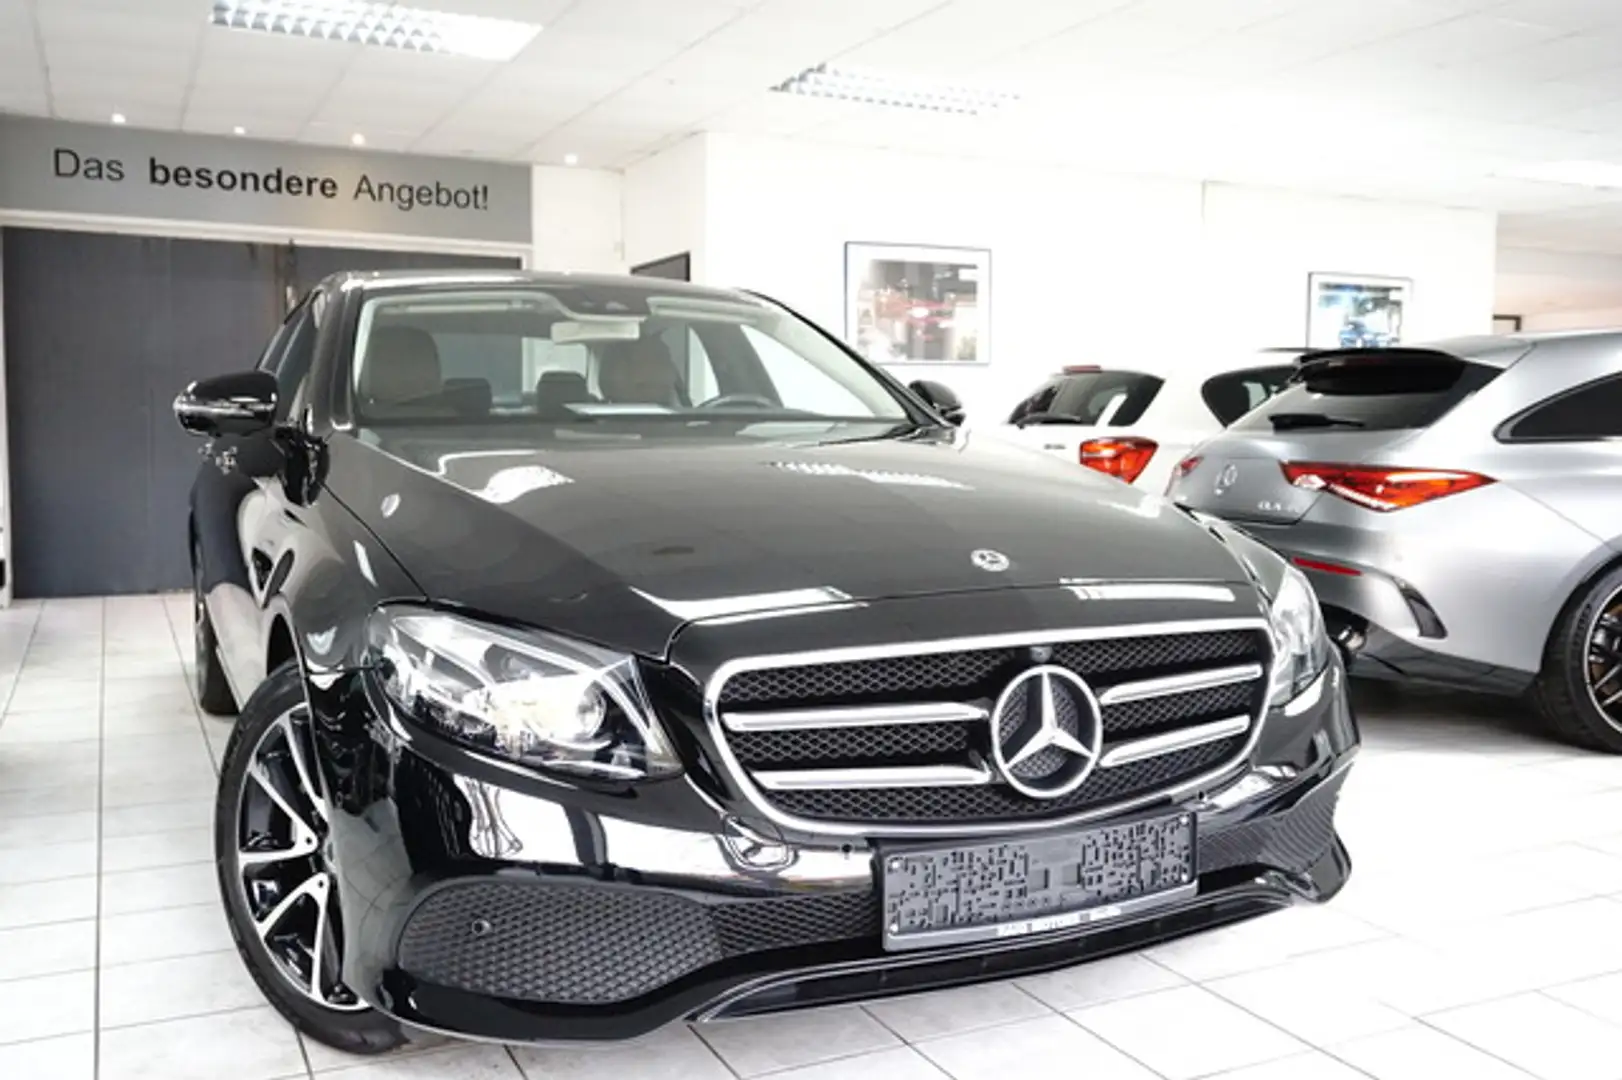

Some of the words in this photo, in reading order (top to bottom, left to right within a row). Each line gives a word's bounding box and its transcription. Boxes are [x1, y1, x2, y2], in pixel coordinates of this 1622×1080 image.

[53, 148, 125, 182] Das
[149, 156, 339, 198] besondere
[353, 174, 489, 211] Angebot!
